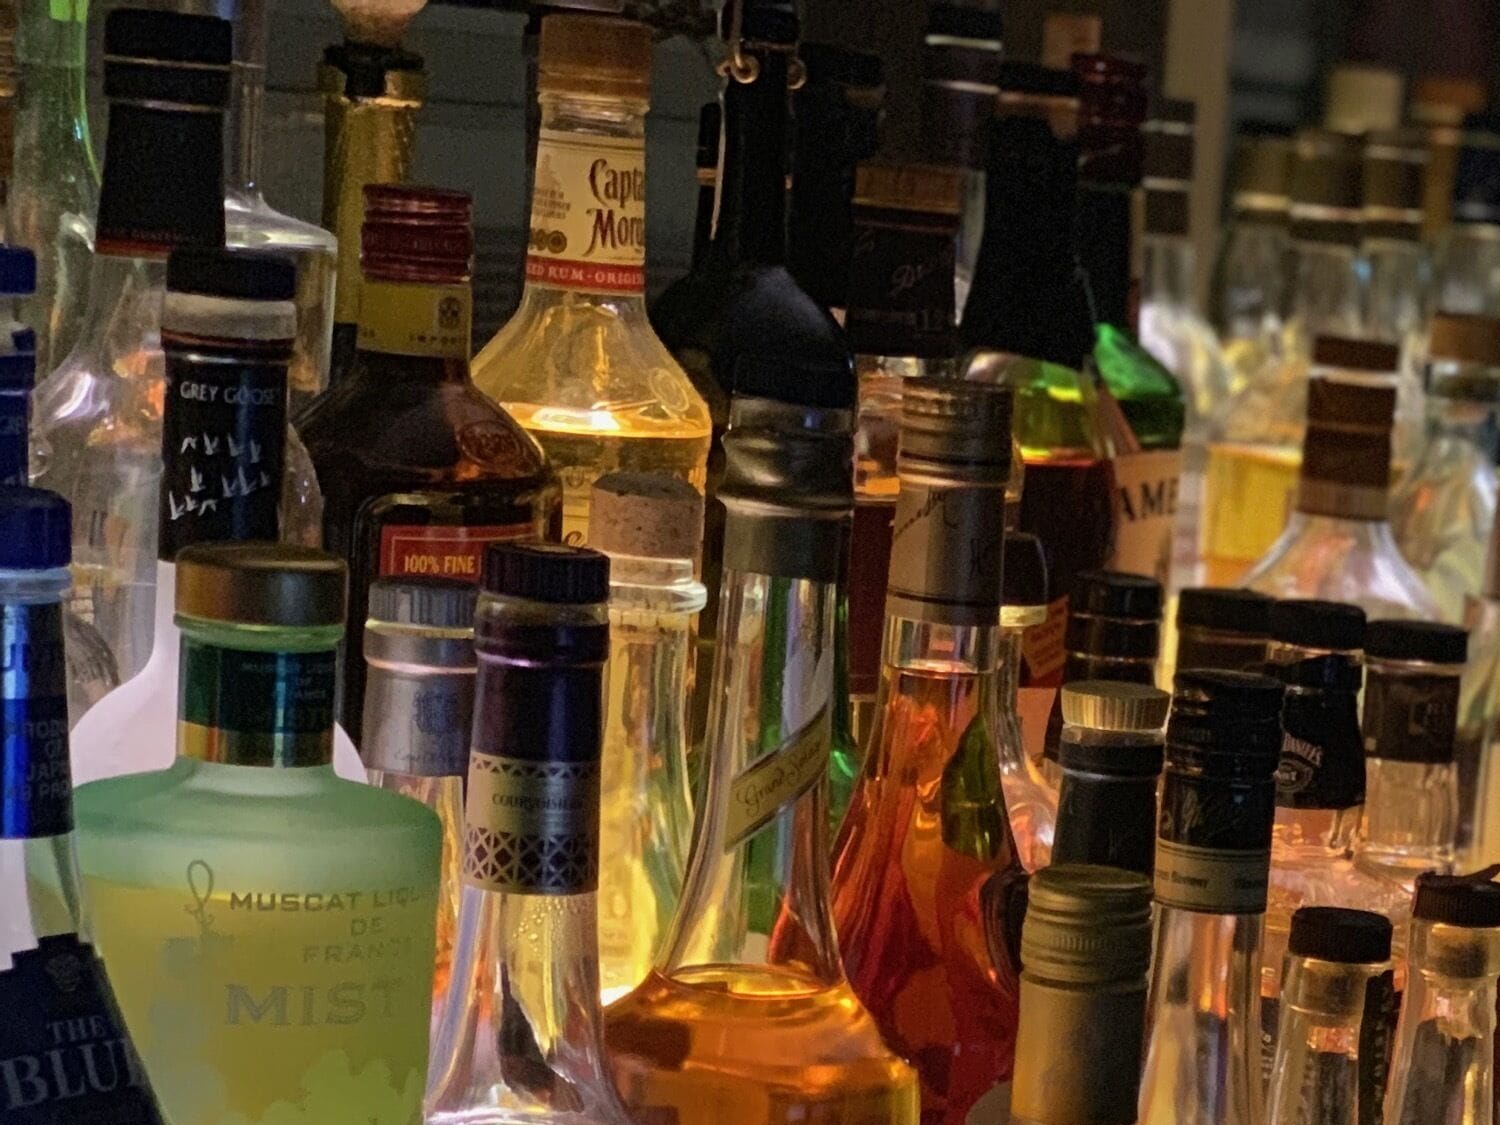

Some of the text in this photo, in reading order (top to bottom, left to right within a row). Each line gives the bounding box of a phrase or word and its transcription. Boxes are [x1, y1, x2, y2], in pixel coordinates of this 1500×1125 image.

[548, 266, 584, 281] RUM
[180, 380, 219, 402] GREY
[403, 554, 476, 575] 100% FINE
[229, 892, 361, 912] MUSCAT
[350, 916, 385, 936] DE
[46, 1013, 108, 1046] THE
